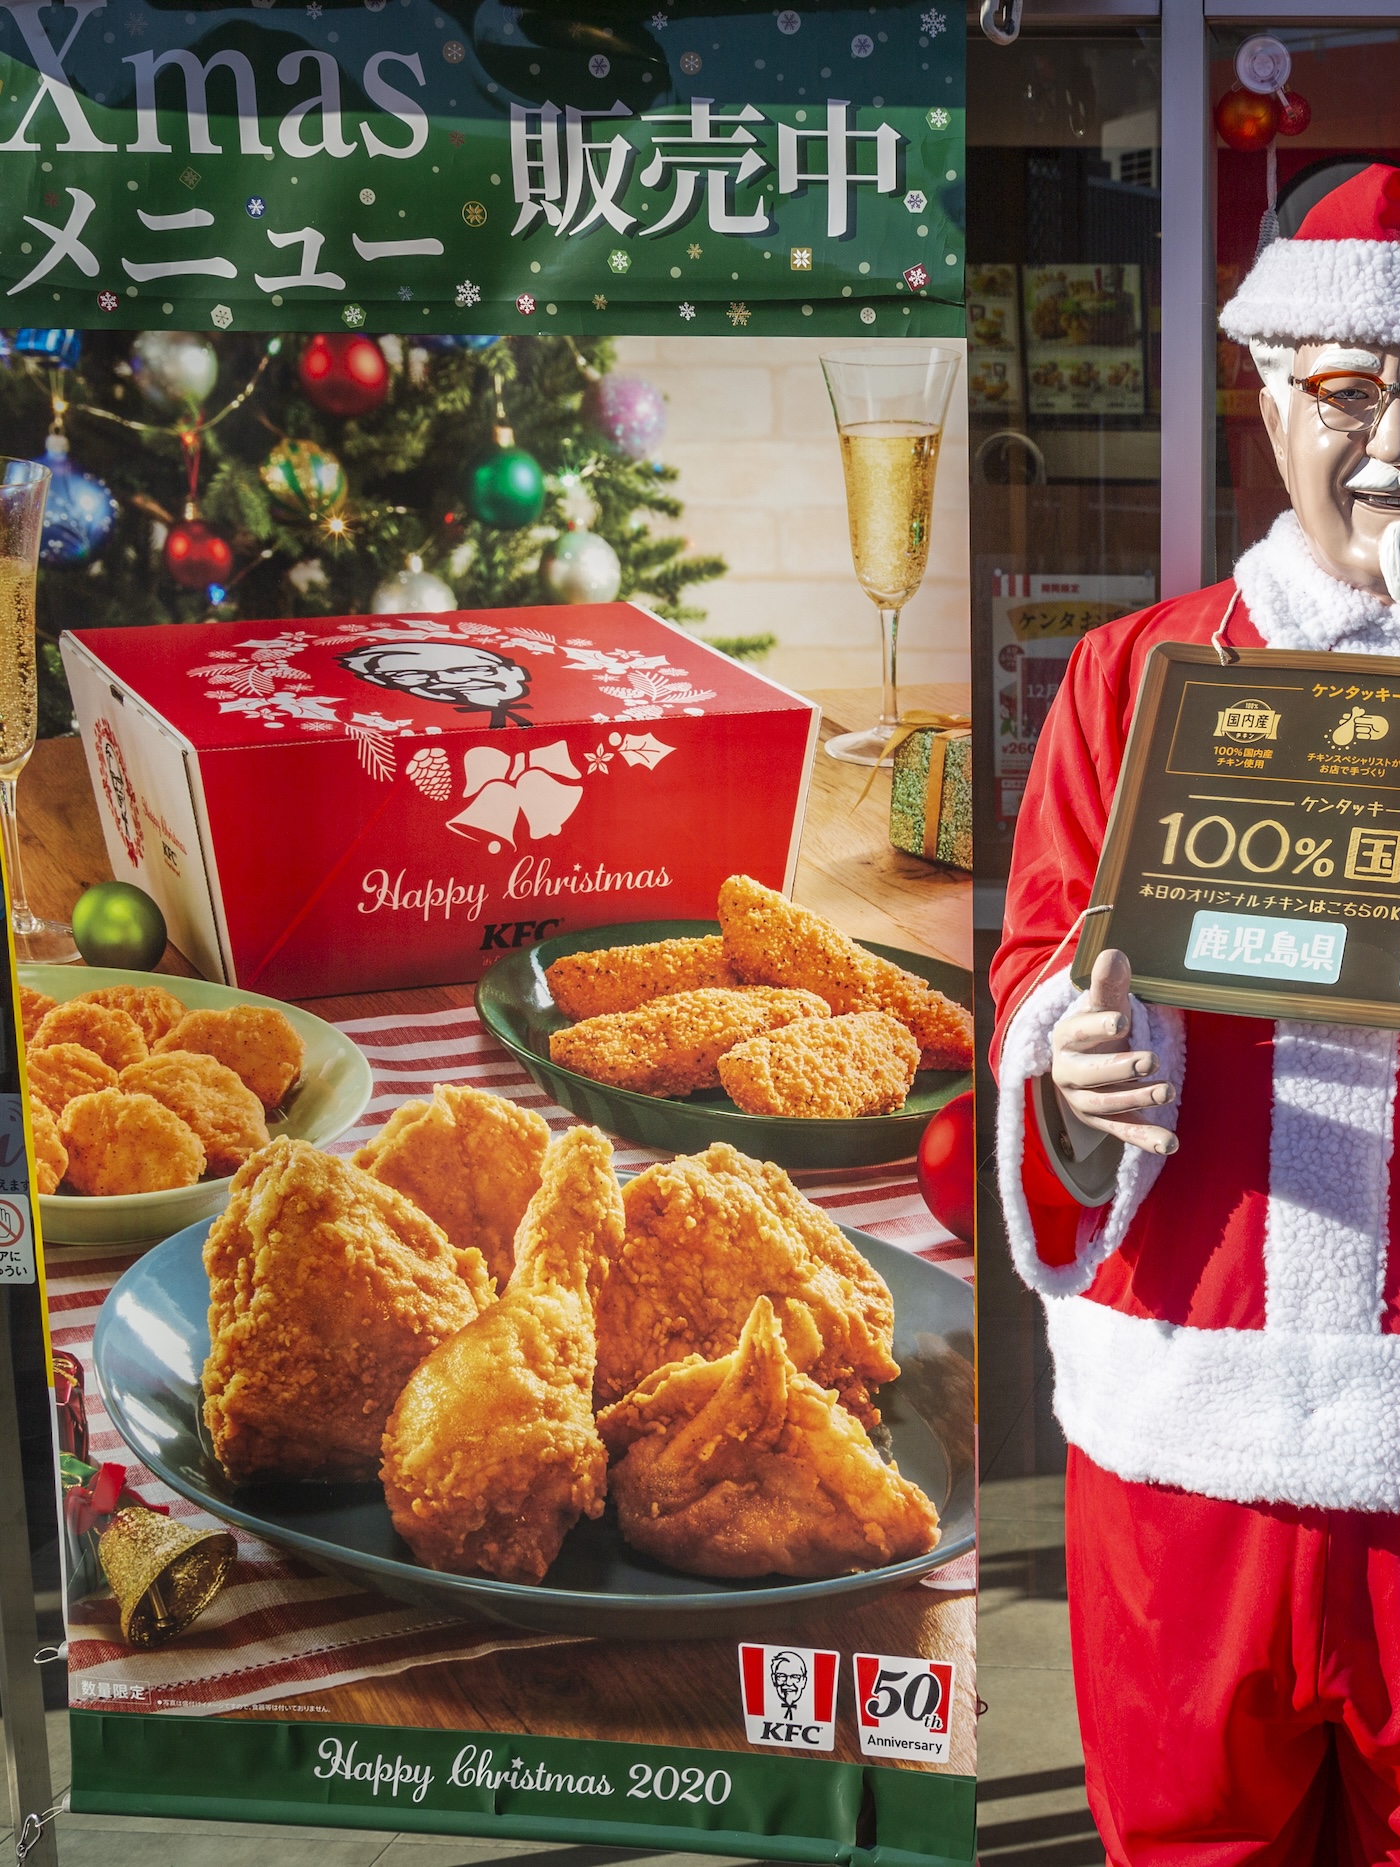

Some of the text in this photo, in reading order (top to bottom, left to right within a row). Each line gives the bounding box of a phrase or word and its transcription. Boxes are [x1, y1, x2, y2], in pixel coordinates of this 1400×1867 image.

[0, 0, 430, 158] Xmas
[510, 98, 905, 240] 販売中
[6, 187, 446, 296] メニュー
[1226, 712, 1270, 729] 国内産
[1213, 745, 1274, 759] 100%国内産
[1216, 757, 1265, 769] チキン使用
[1318, 764, 1387, 778] お店で手づくり
[357, 855, 674, 921] Happy Christmas
[479, 918, 560, 951] KFC
[1191, 923, 1337, 972] 鹿児島県
[80, 1680, 146, 1701] 数量限定
[760, 1721, 821, 1745] KFC
[867, 1734, 943, 1754] Anniversary
[313, 1737, 733, 1806] Happy Christmas 2020
